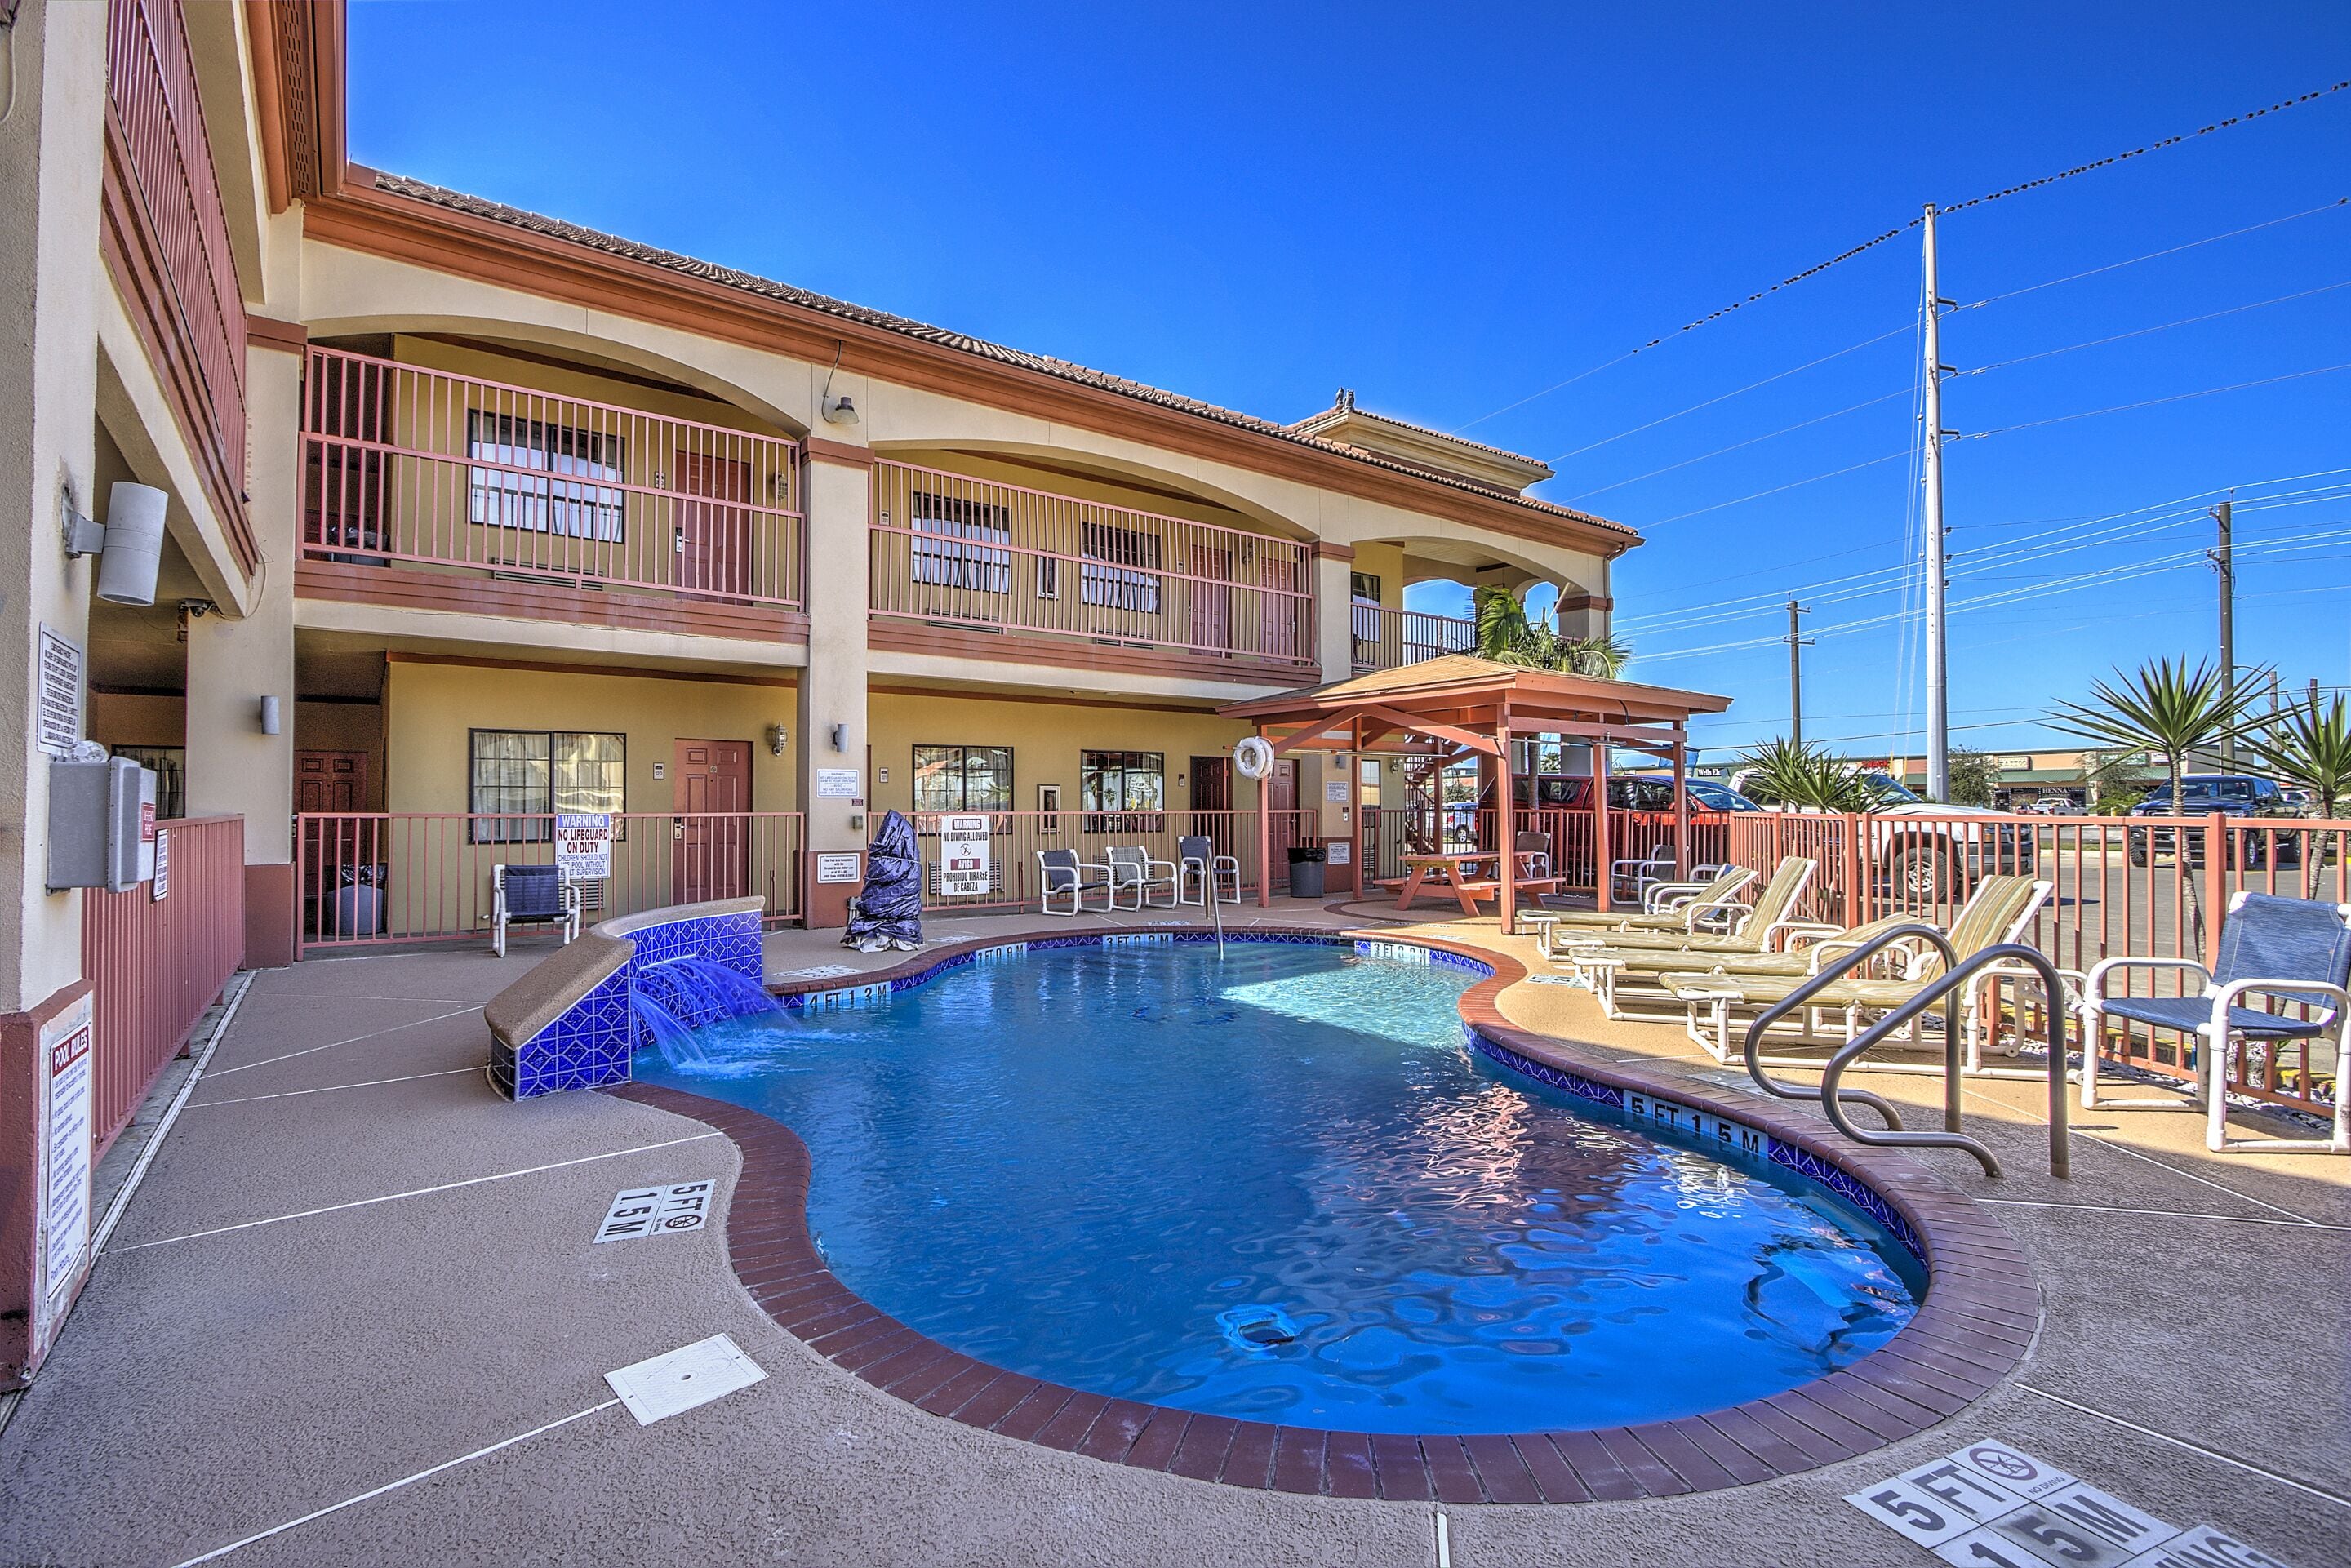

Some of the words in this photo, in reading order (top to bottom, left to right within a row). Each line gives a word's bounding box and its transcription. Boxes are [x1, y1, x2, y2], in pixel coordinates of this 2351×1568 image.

[562, 815, 605, 828] WARNING
[953, 820, 980, 829] WARNING
[558, 828, 568, 841] NO
[570, 828, 608, 841] LIFEGUARD
[943, 832, 949, 842] NO
[950, 832, 967, 842] DIVING
[967, 831, 989, 841] ALLOWED
[567, 842, 577, 854] ON
[580, 842, 599, 853] DUTY
[958, 860, 974, 870] AVISO
[576, 868, 606, 876] SUPERVISION
[943, 872, 968, 882] PROHIBIDO
[953, 882, 960, 892] DE
[960, 882, 979, 892] CABEZA
[1118, 936, 1130, 945] FT
[984, 949, 993, 958] FT
[1016, 944, 1024, 953] M
[1384, 944, 1394, 957] FT
[809, 994, 818, 1006] 4
[824, 992, 841, 1005] FT
[848, 989, 855, 1001] 1
[864, 987, 872, 998] 2
[878, 984, 887, 996] M
[55, 1042, 70, 1071] POOL
[70, 1029, 87, 1059] RULES
[1631, 1096, 1645, 1115] 5
[1655, 1103, 1679, 1124] FT
[1691, 1114, 1700, 1132] 1
[1718, 1122, 1732, 1143] 5
[1742, 1130, 1759, 1153] M
[672, 1184, 709, 1195] 5
[664, 1196, 704, 1212] FT
[604, 1219, 647, 1237] M
[2028, 1486, 2041, 1495] NO
[2041, 1475, 2066, 1492] DIVING
[1869, 1489, 1946, 1531] 5
[1911, 1464, 2006, 1515] FT
[2053, 1494, 2151, 1544] M
[2011, 1514, 2100, 1562] 5
